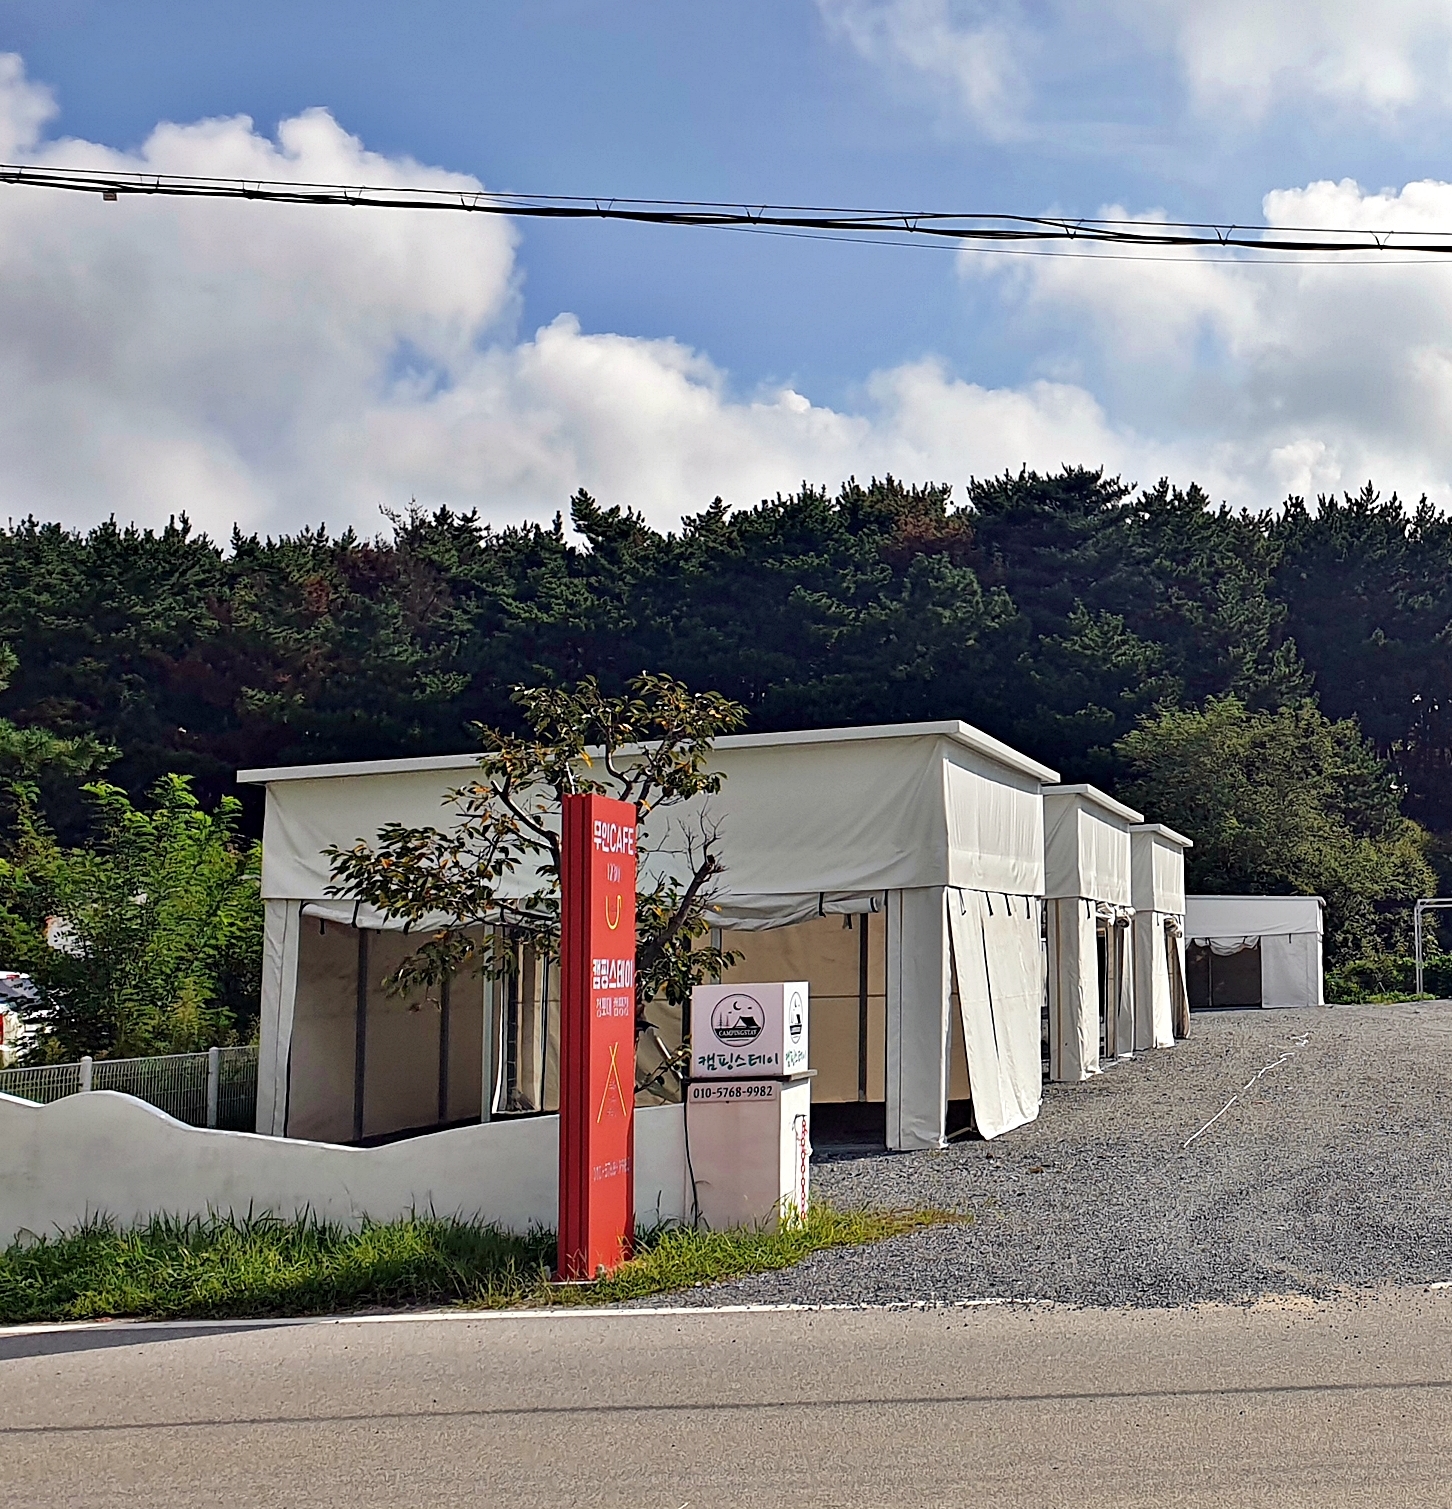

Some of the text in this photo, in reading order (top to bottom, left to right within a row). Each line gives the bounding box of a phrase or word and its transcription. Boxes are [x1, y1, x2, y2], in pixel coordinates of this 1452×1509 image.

[593, 820, 635, 856] 무인CAFE
[592, 958, 633, 990] 캠핑스테이
[698, 1053, 779, 1071] 캠핑스테이
[693, 1085, 773, 1099] 010-5768-9982
